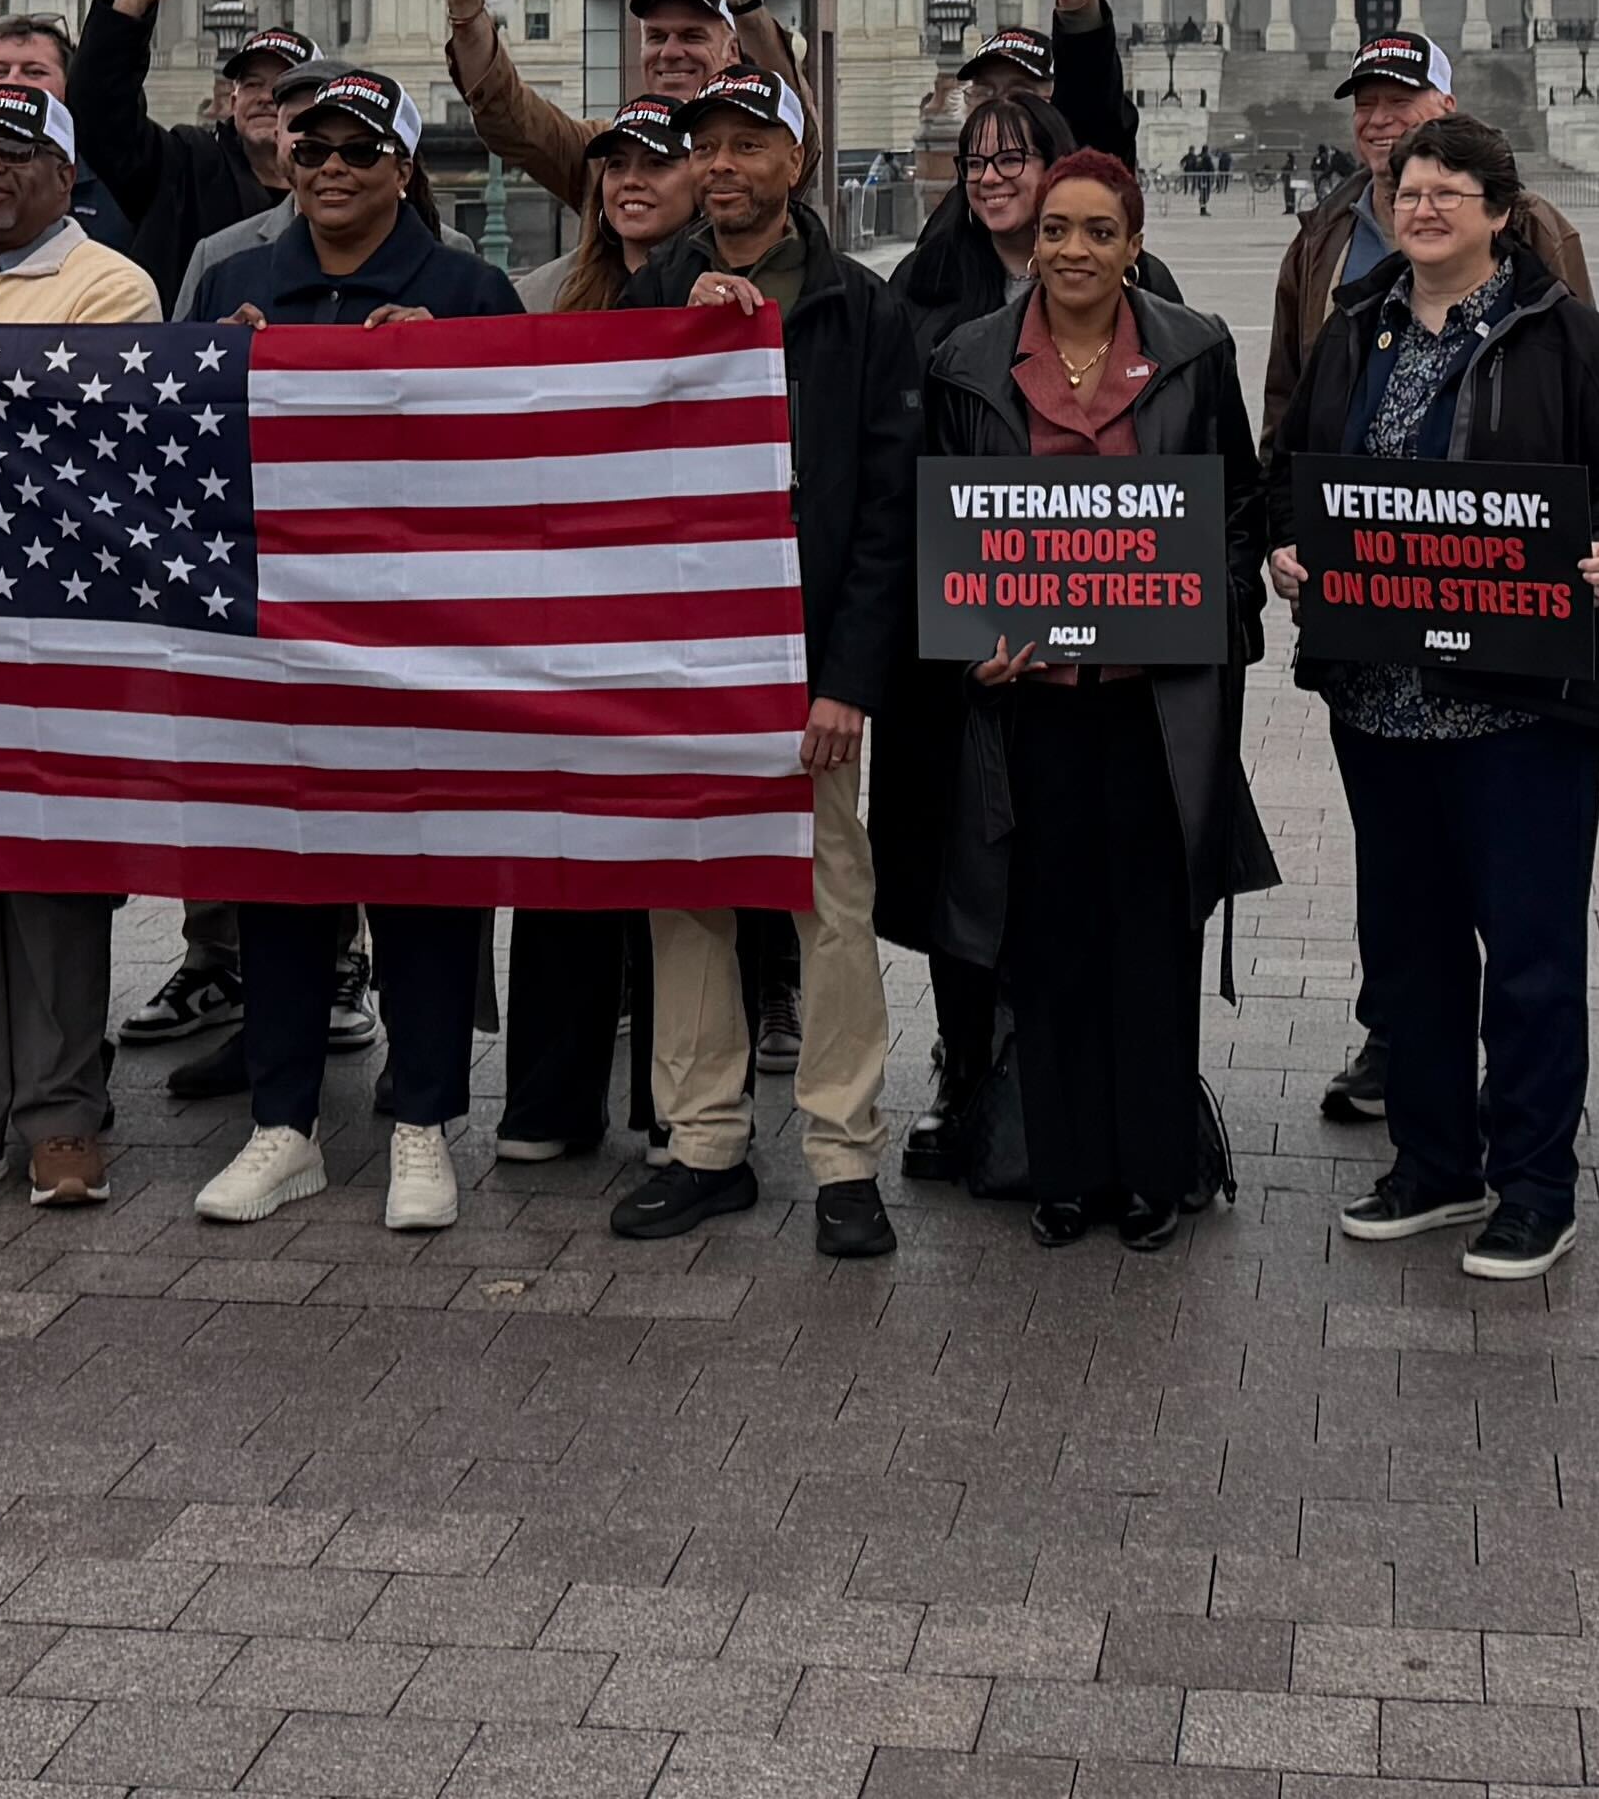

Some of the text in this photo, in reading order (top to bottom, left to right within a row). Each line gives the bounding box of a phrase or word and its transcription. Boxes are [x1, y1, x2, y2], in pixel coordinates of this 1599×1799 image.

[951, 484, 1185, 518] VETERANS SAY:
[1322, 483, 1550, 528] VETERANS SAY:
[981, 529, 1157, 562] NO TROOPS
[1354, 529, 1525, 570] NO TROOPS
[944, 572, 1202, 607] ON OUR STREETS
[1323, 570, 1571, 619] ON OUR STREETS
[1049, 627, 1095, 645] ACLU
[1425, 630, 1470, 650] ACLU
